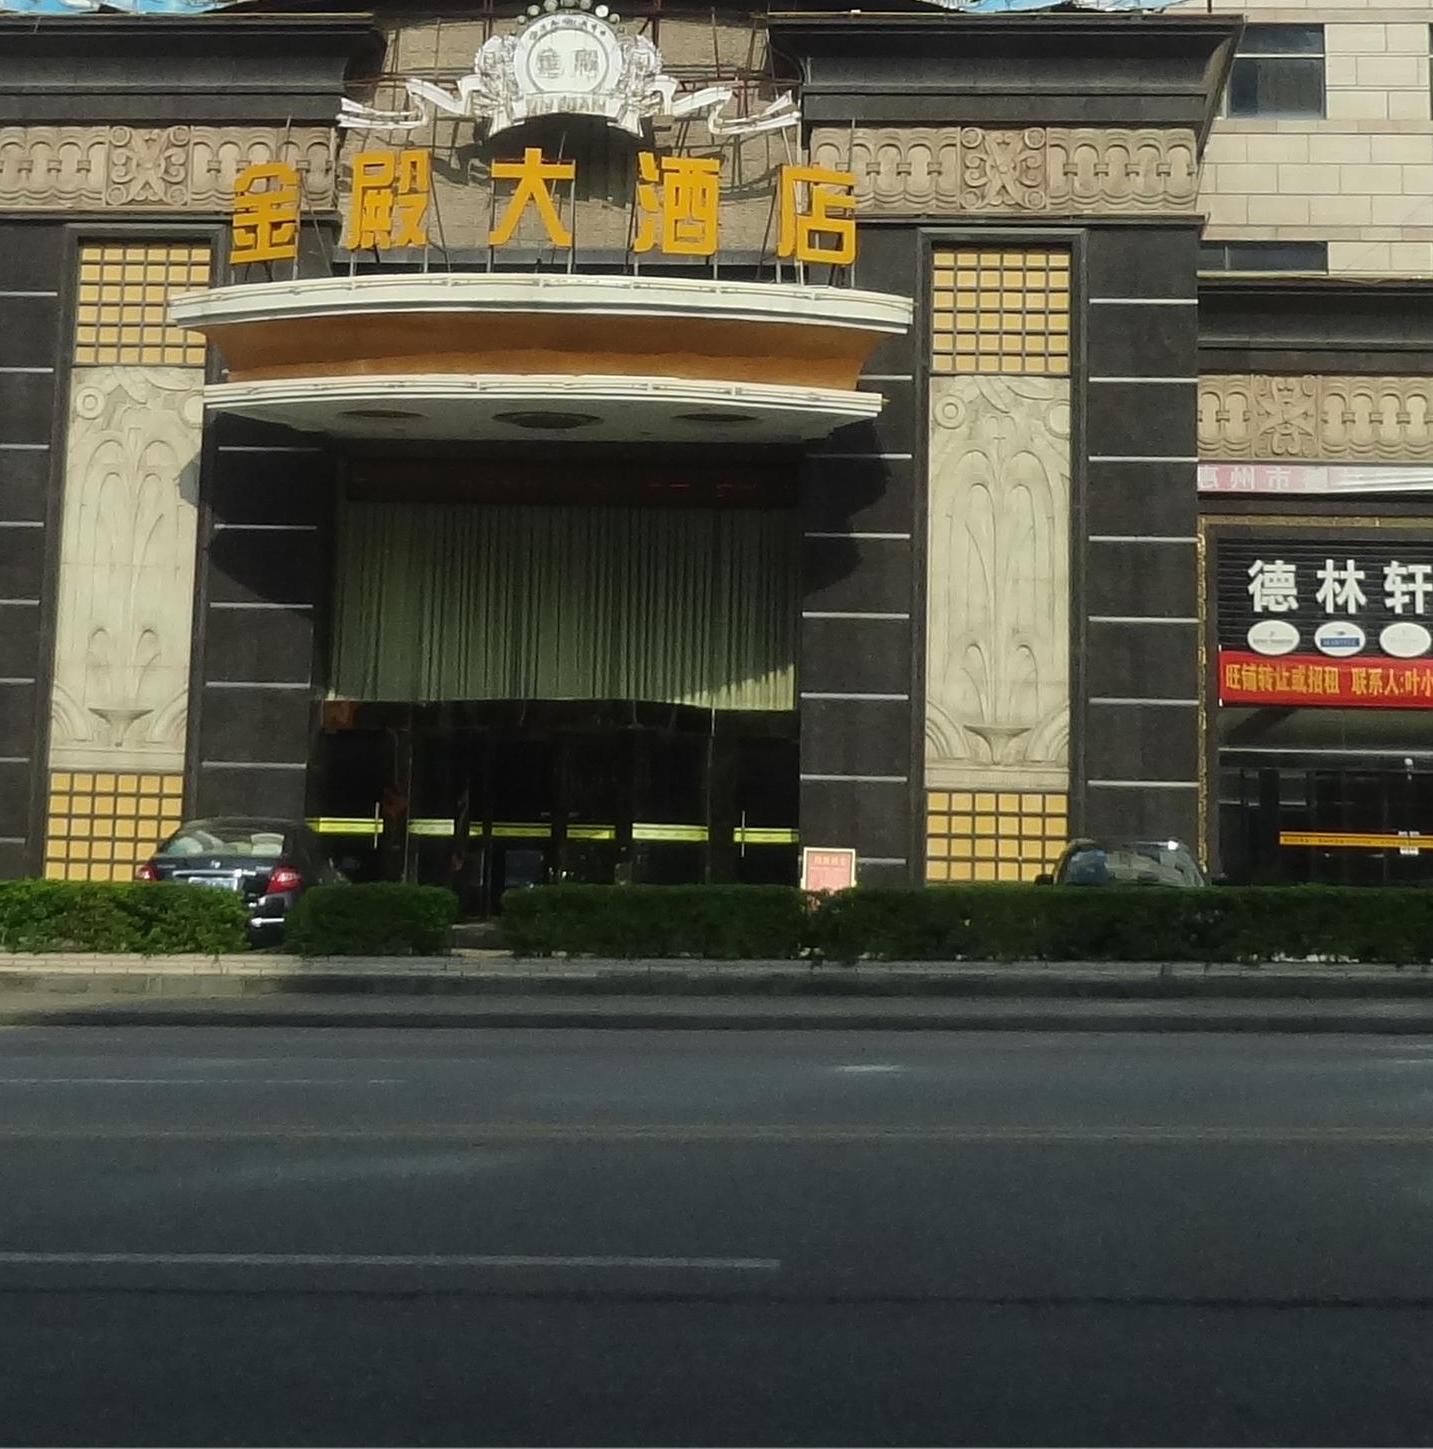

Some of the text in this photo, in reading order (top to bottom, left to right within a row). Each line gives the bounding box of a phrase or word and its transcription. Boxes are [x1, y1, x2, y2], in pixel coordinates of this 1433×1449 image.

[230, 148, 856, 266] 金殿大酒店
